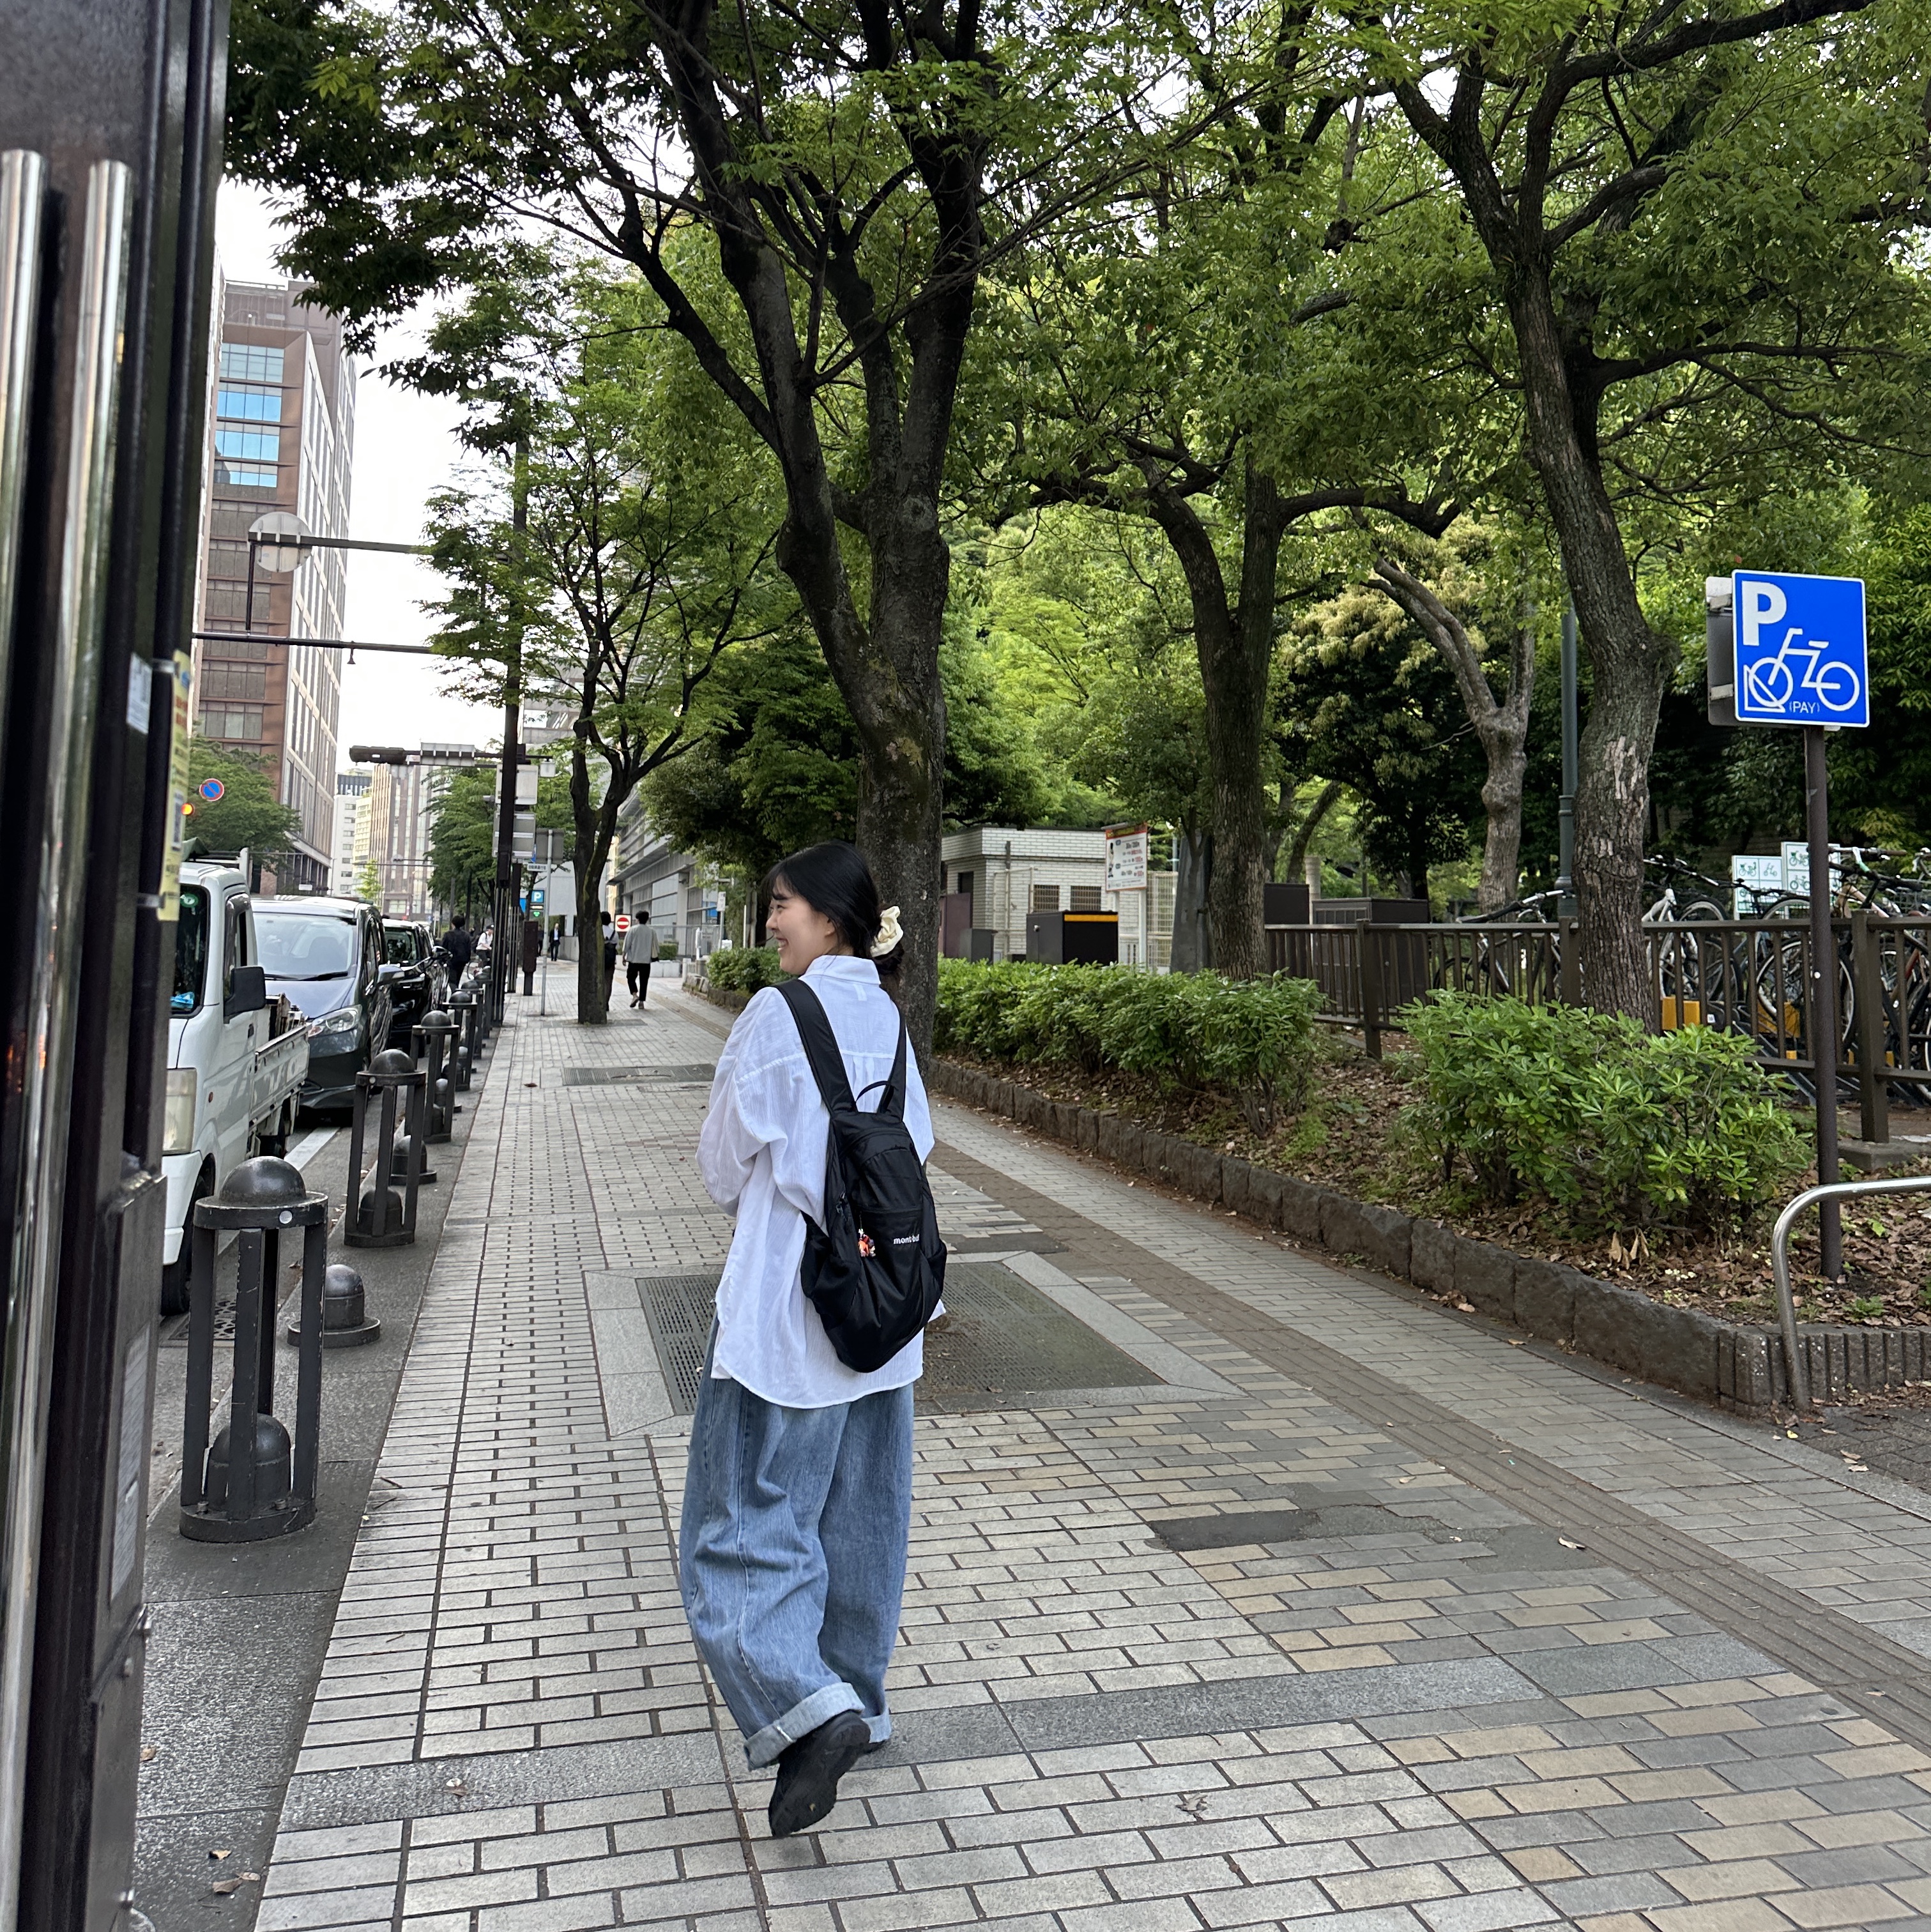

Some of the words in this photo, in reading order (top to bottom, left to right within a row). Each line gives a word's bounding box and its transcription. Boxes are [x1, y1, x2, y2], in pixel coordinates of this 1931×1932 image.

[1741, 580, 1787, 646] P
[1789, 701, 1820, 714] (PAY)
[533, 892, 542, 902] P
[893, 1233, 920, 1245] mont-bl
